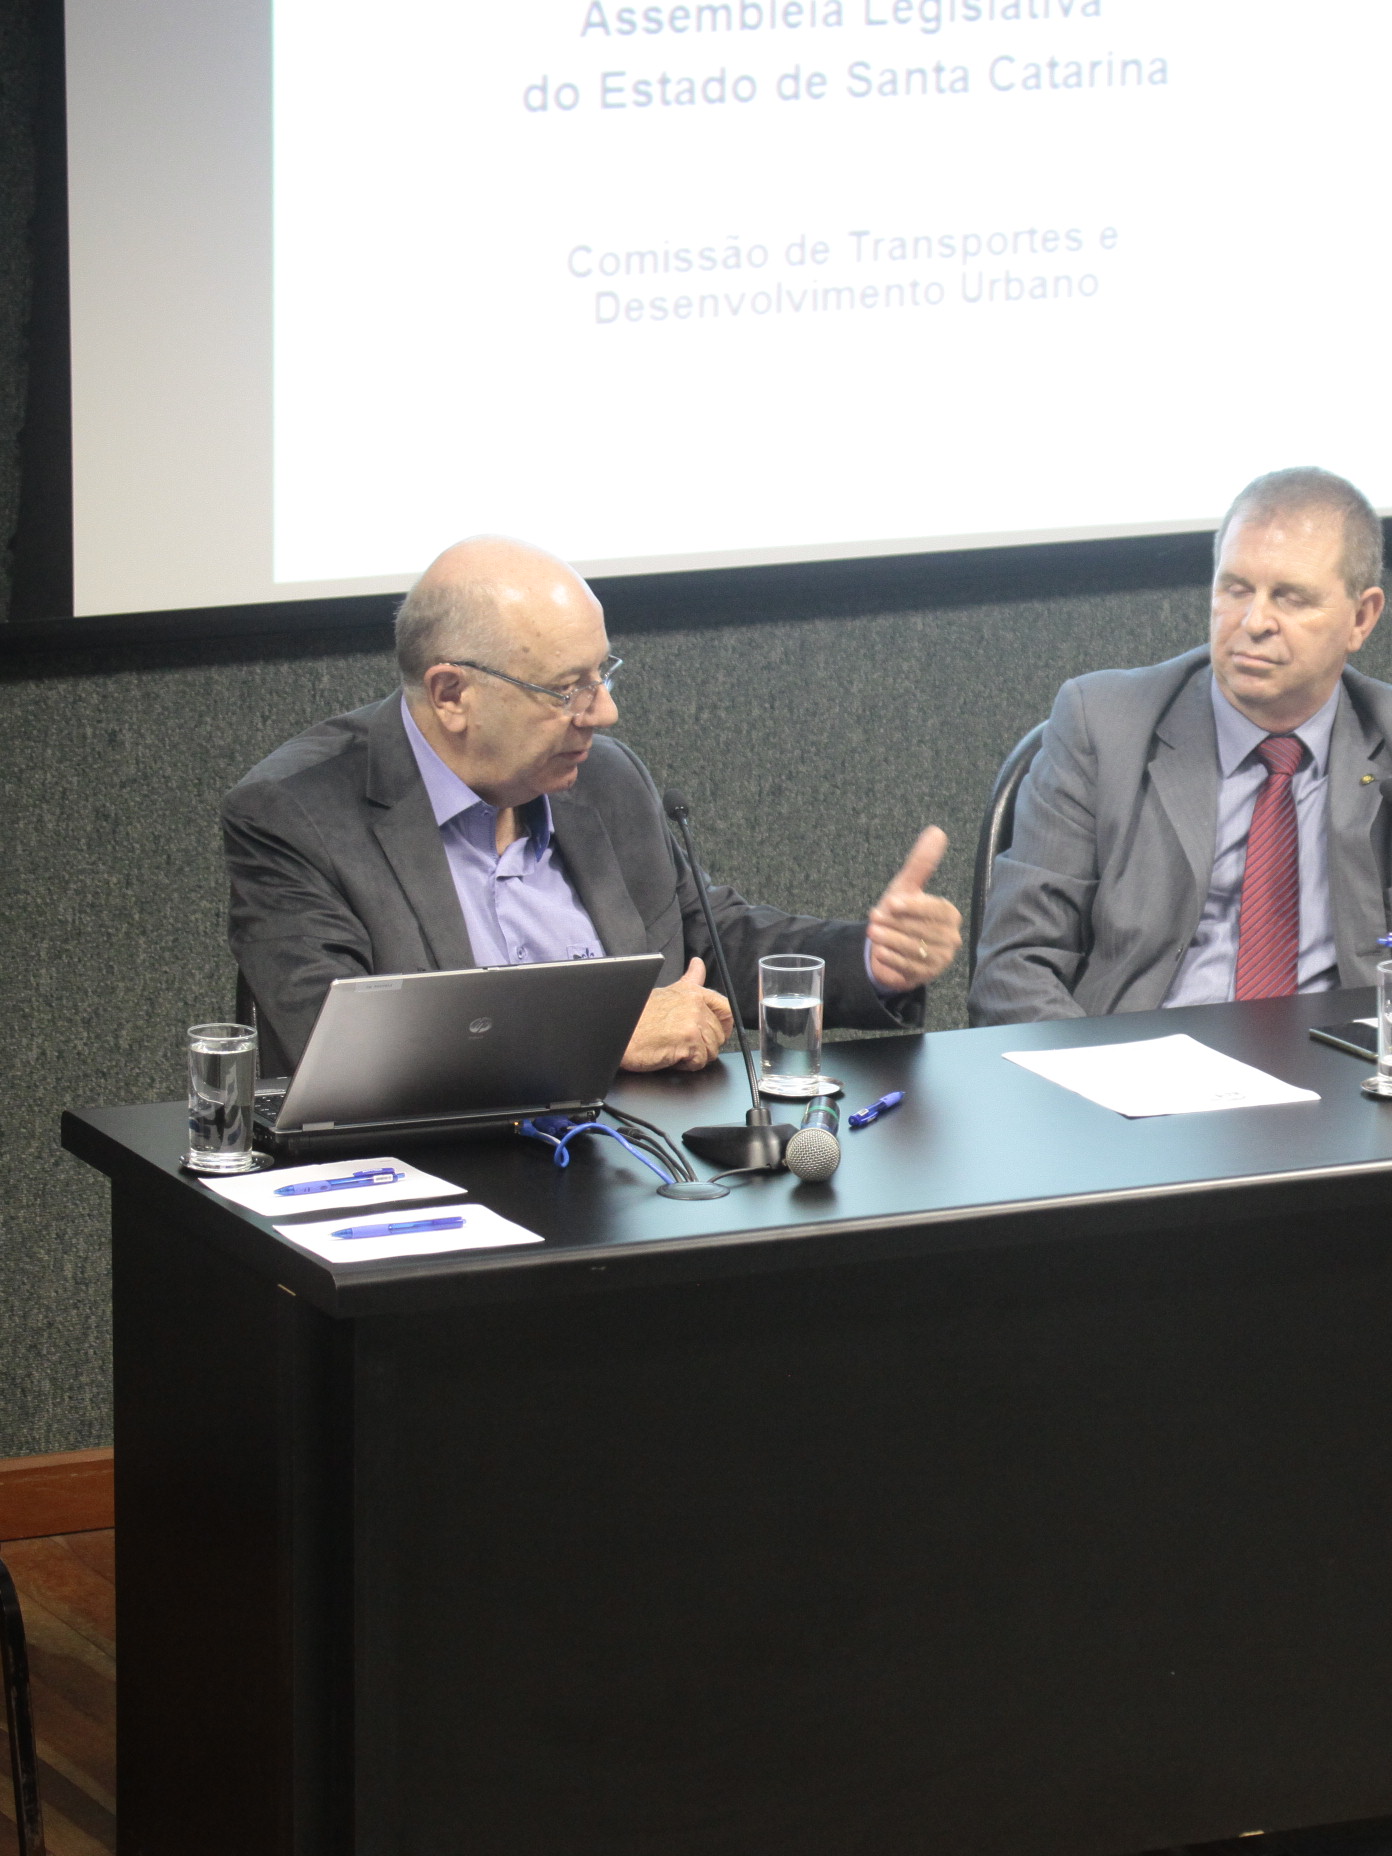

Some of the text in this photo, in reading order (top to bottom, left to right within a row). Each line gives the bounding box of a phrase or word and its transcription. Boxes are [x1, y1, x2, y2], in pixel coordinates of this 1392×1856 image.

[579, 0, 845, 38] Assembleia
[522, 51, 1169, 113] do Estado de Santa Catarina
[567, 226, 1119, 278] Comissão de Transportes e
[595, 269, 1100, 324] Desenvolvimento Urbano
